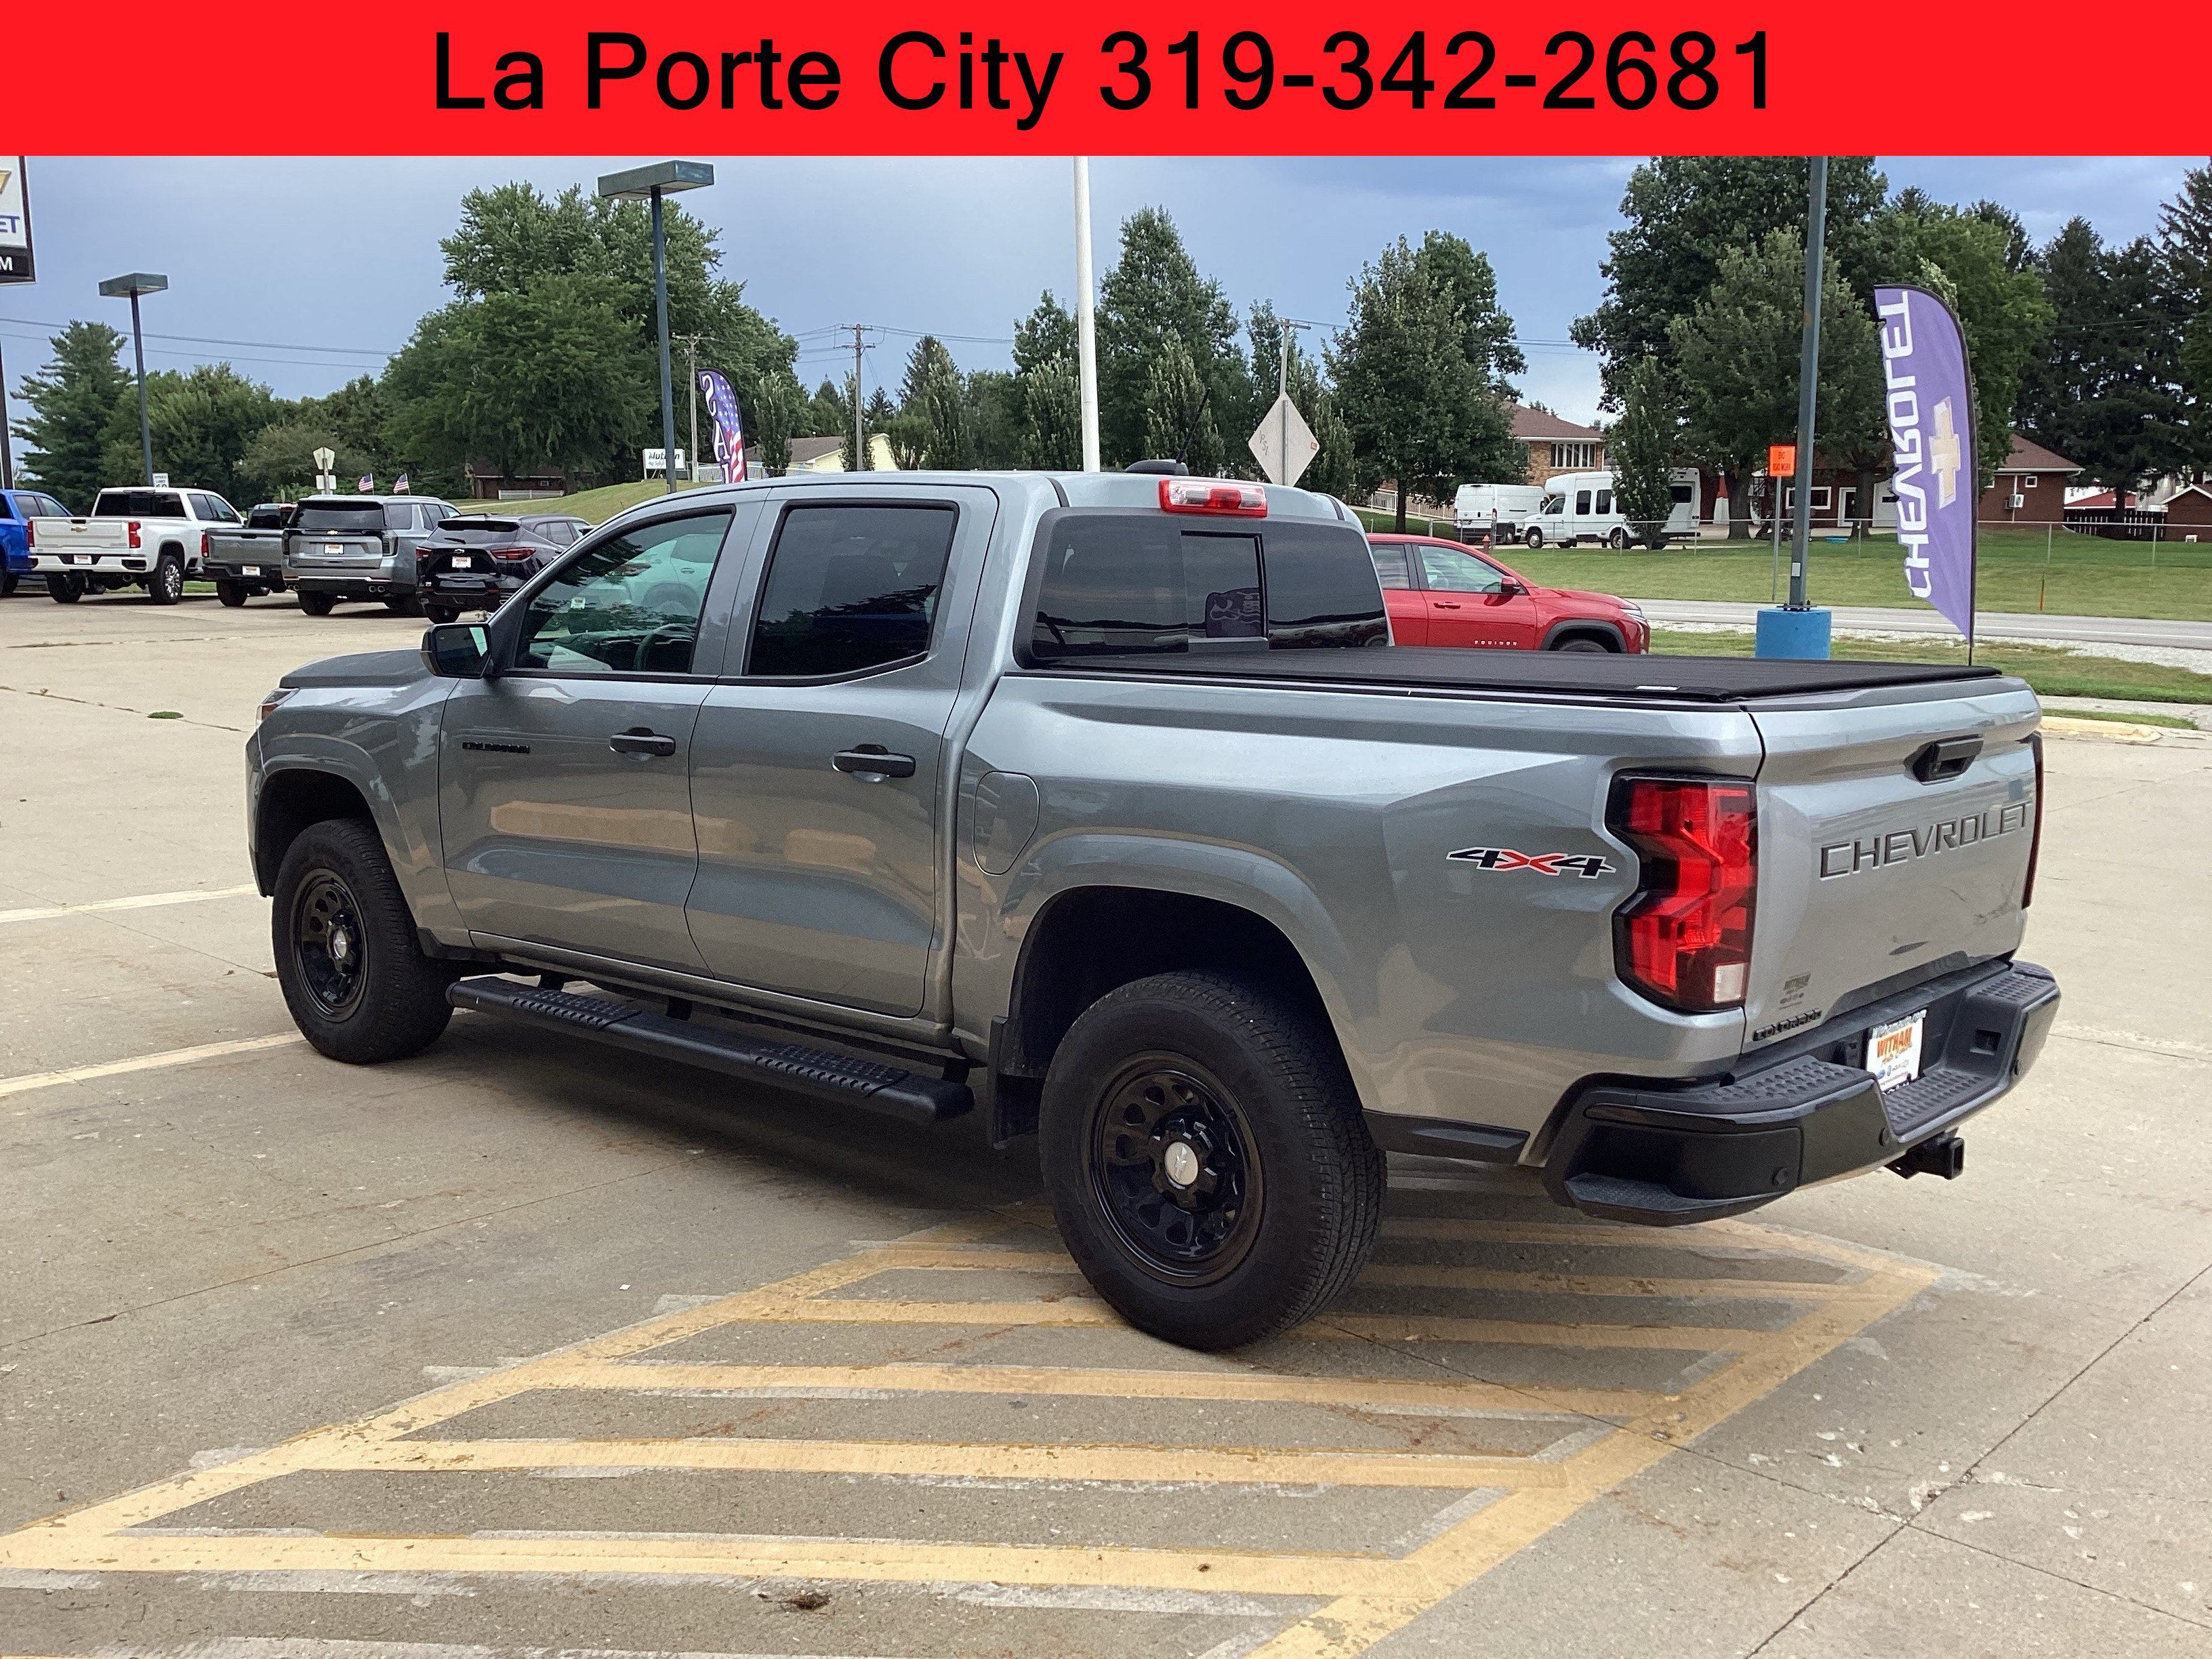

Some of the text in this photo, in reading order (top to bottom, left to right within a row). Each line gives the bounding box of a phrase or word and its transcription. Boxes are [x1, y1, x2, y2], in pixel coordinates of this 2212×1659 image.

[648, 451, 680, 460] Nutn
[1820, 800, 2032, 881] CHEVROLET
[1877, 1027, 1912, 1057] WITHAM
